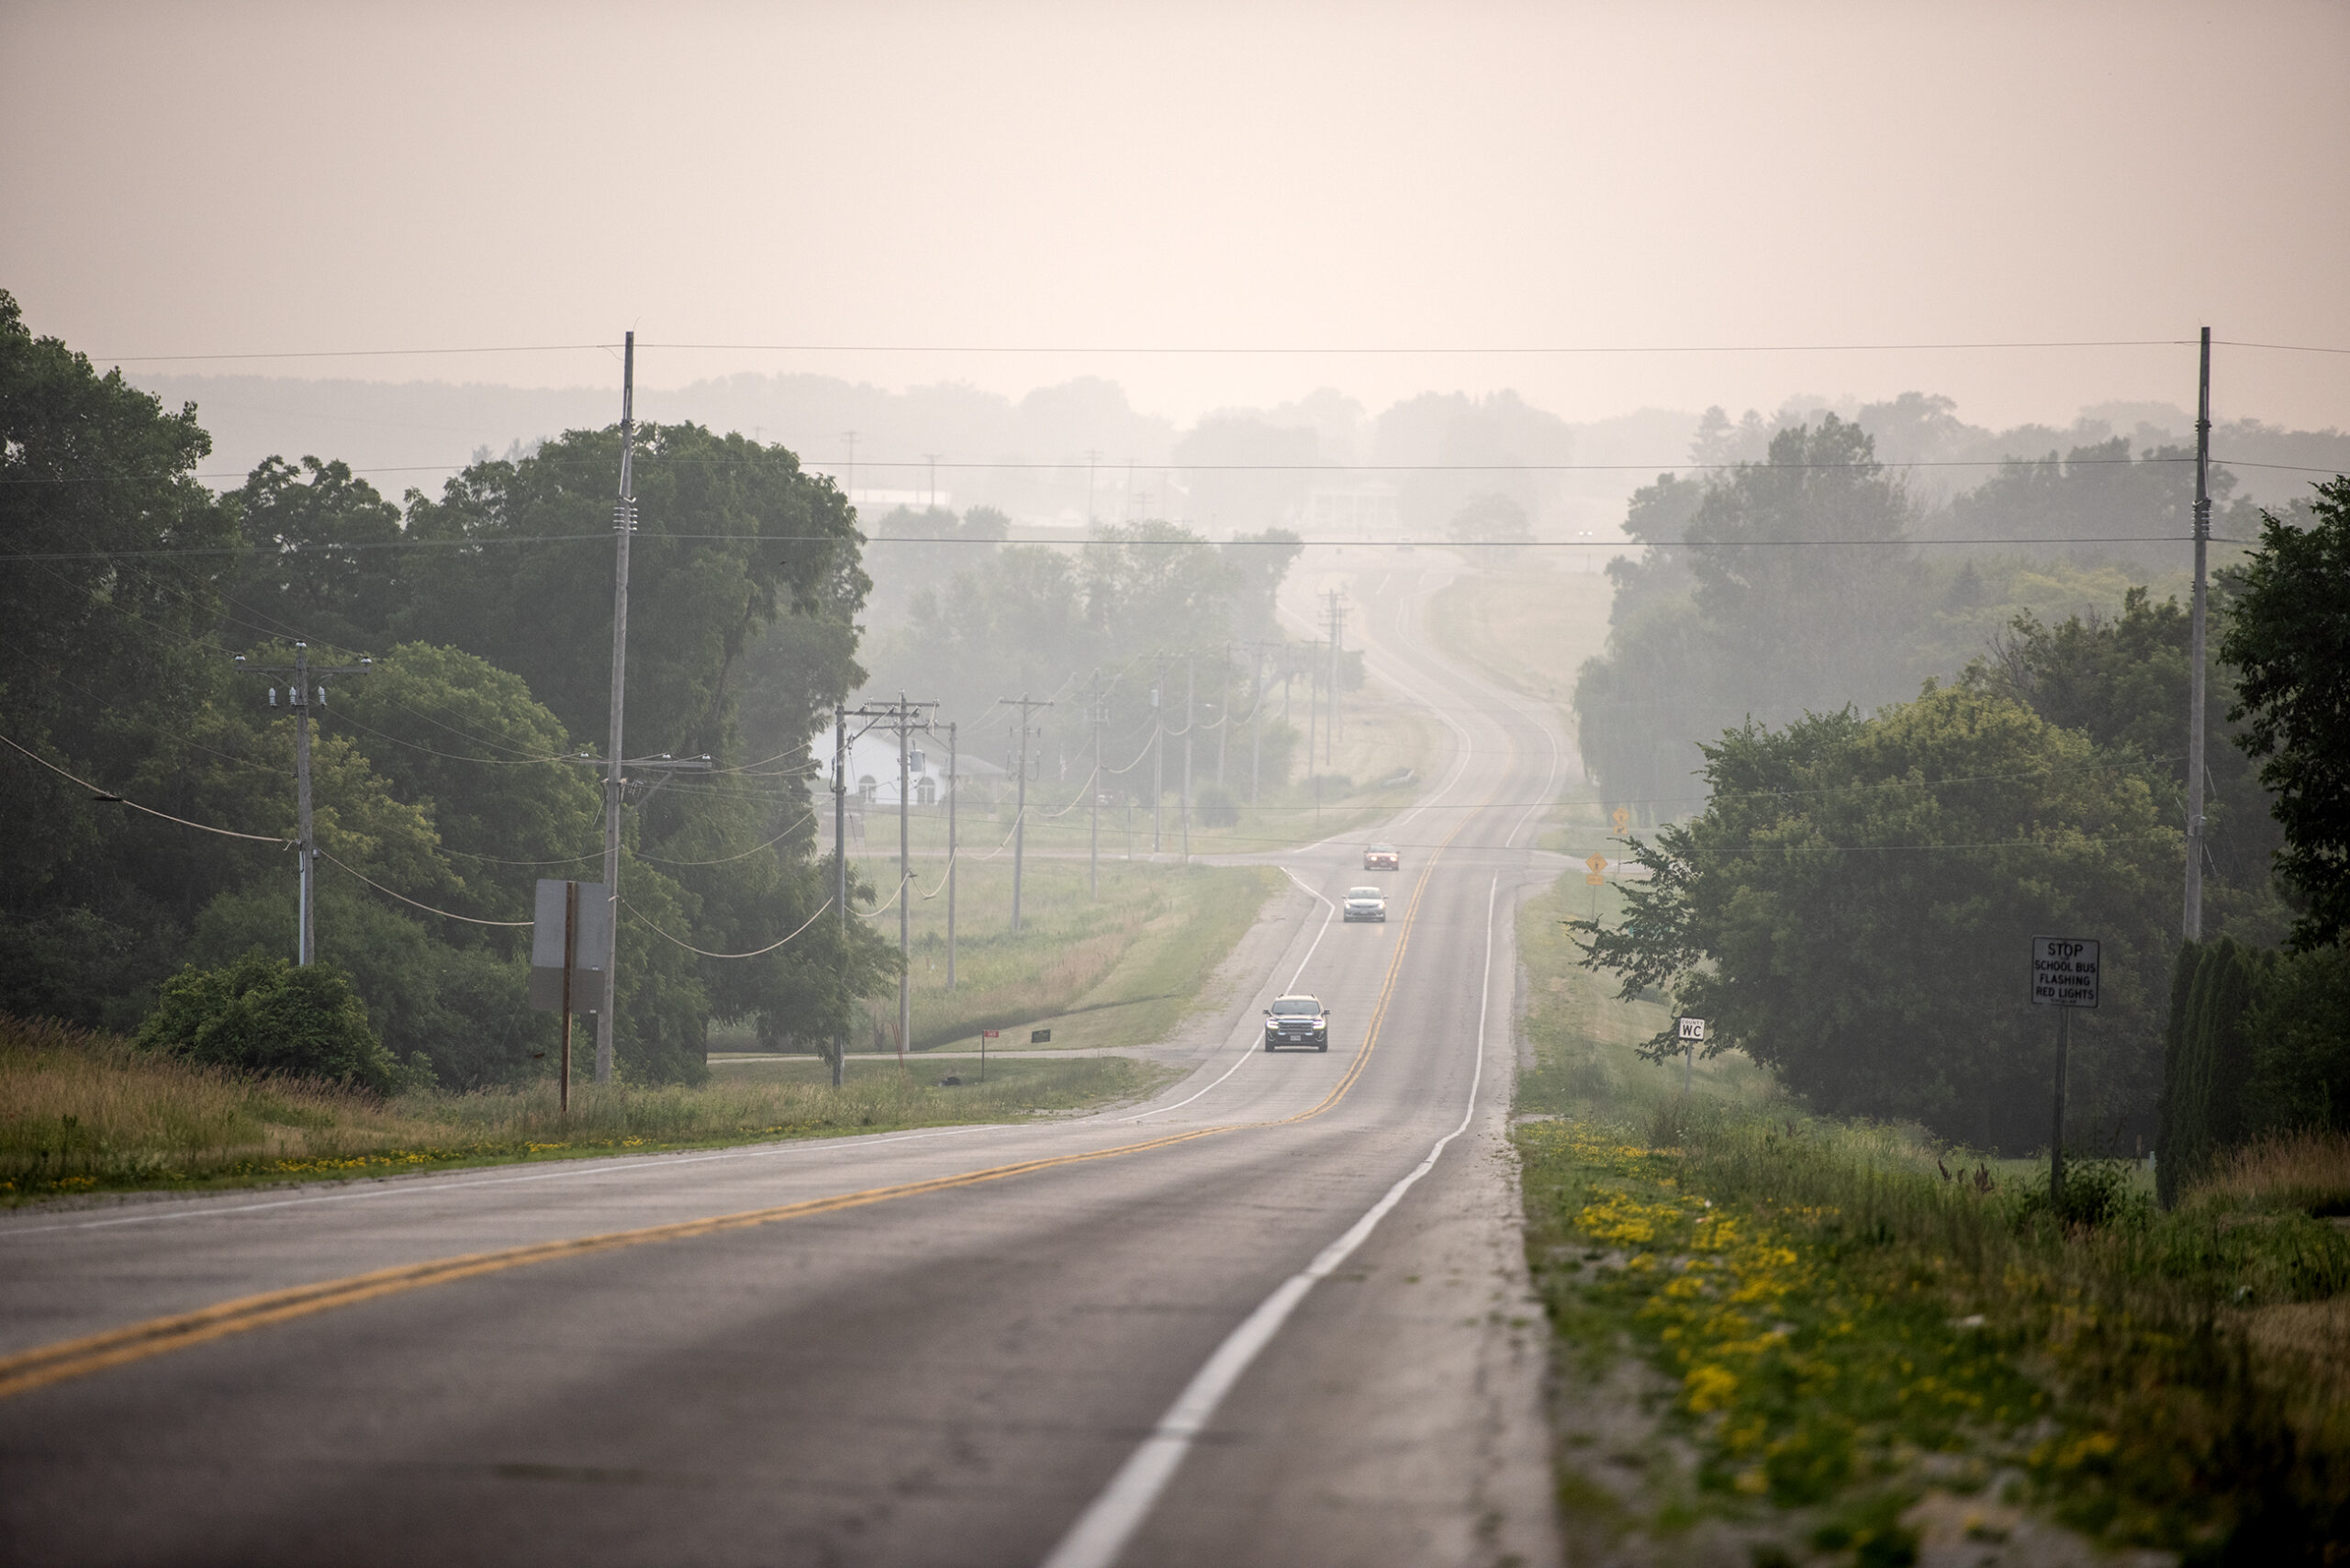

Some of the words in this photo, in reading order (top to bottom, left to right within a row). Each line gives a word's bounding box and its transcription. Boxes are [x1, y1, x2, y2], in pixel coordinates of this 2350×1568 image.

[2048, 942, 2084, 957] STOP
[2035, 959, 2073, 972] SCHOOL
[2076, 962, 2096, 973] BUS
[2040, 973, 2090, 986] FLASHING
[2036, 986, 2055, 997] RED
[2058, 988, 2094, 1000] LIGHTS
[1683, 1025, 1701, 1036] WC
